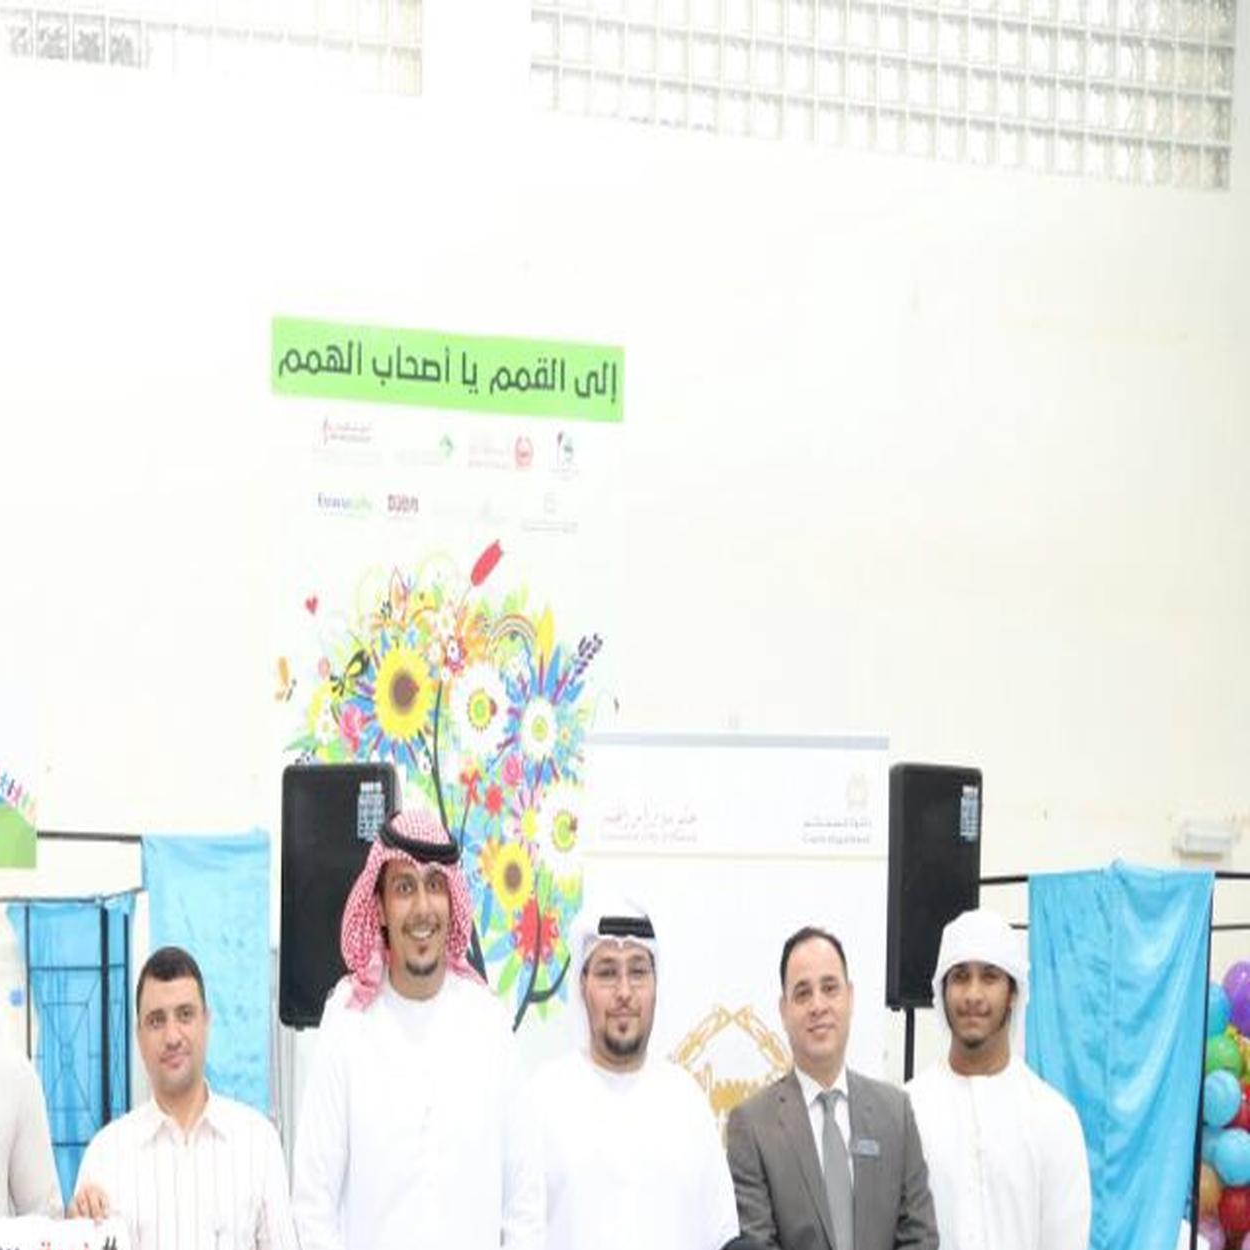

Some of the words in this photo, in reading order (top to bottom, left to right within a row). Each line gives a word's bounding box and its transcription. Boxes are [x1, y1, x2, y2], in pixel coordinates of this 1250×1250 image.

[277, 340, 363, 377] الهمم
[372, 346, 451, 386] أصحاب
[460, 350, 479, 394] يا
[489, 357, 565, 396] القمم
[574, 362, 618, 403] إلى
